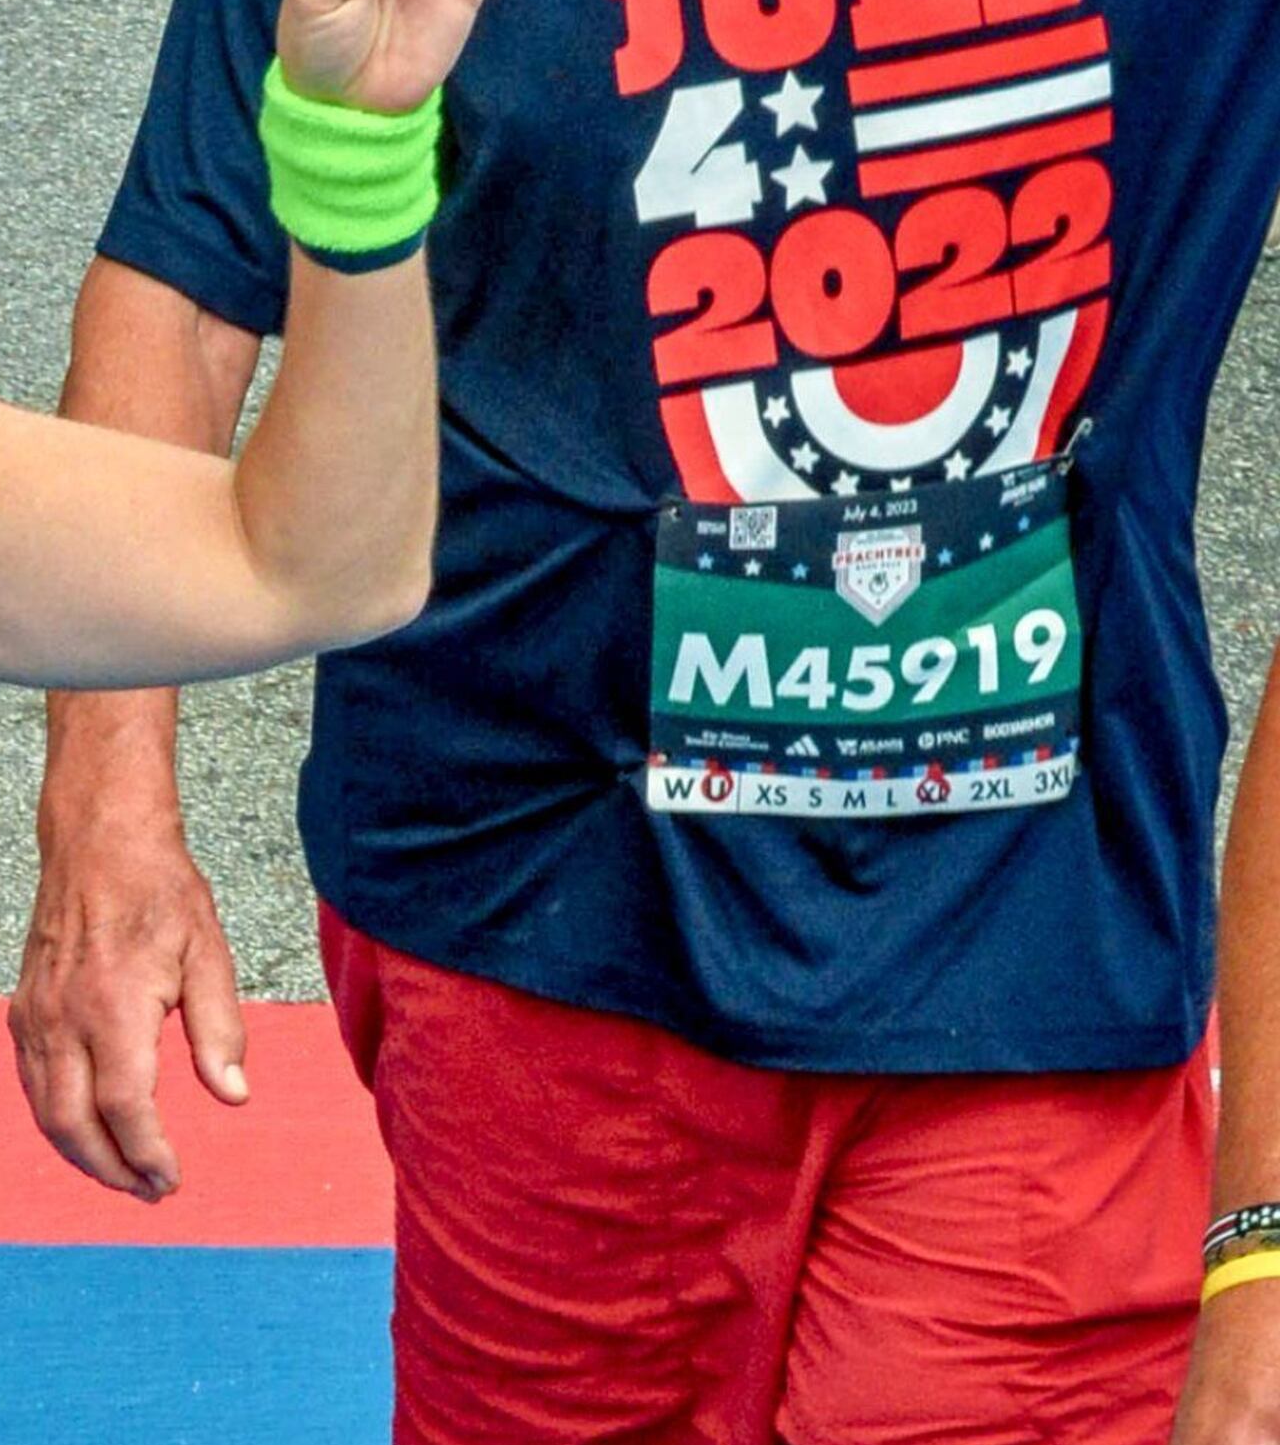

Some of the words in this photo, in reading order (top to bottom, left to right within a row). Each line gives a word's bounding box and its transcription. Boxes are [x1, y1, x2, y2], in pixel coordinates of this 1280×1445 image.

[632, 77, 763, 228] 4
[646, 157, 1114, 386] 2022
[886, 499, 919, 518] 2023
[667, 608, 1068, 712] M45919
[937, 728, 971, 746] PNC
[664, 776, 695, 800] W
[755, 783, 788, 806] XS
[808, 786, 823, 808] S
[842, 788, 867, 810] M
[886, 787, 898, 808] L
[971, 777, 1015, 802] 2XL
